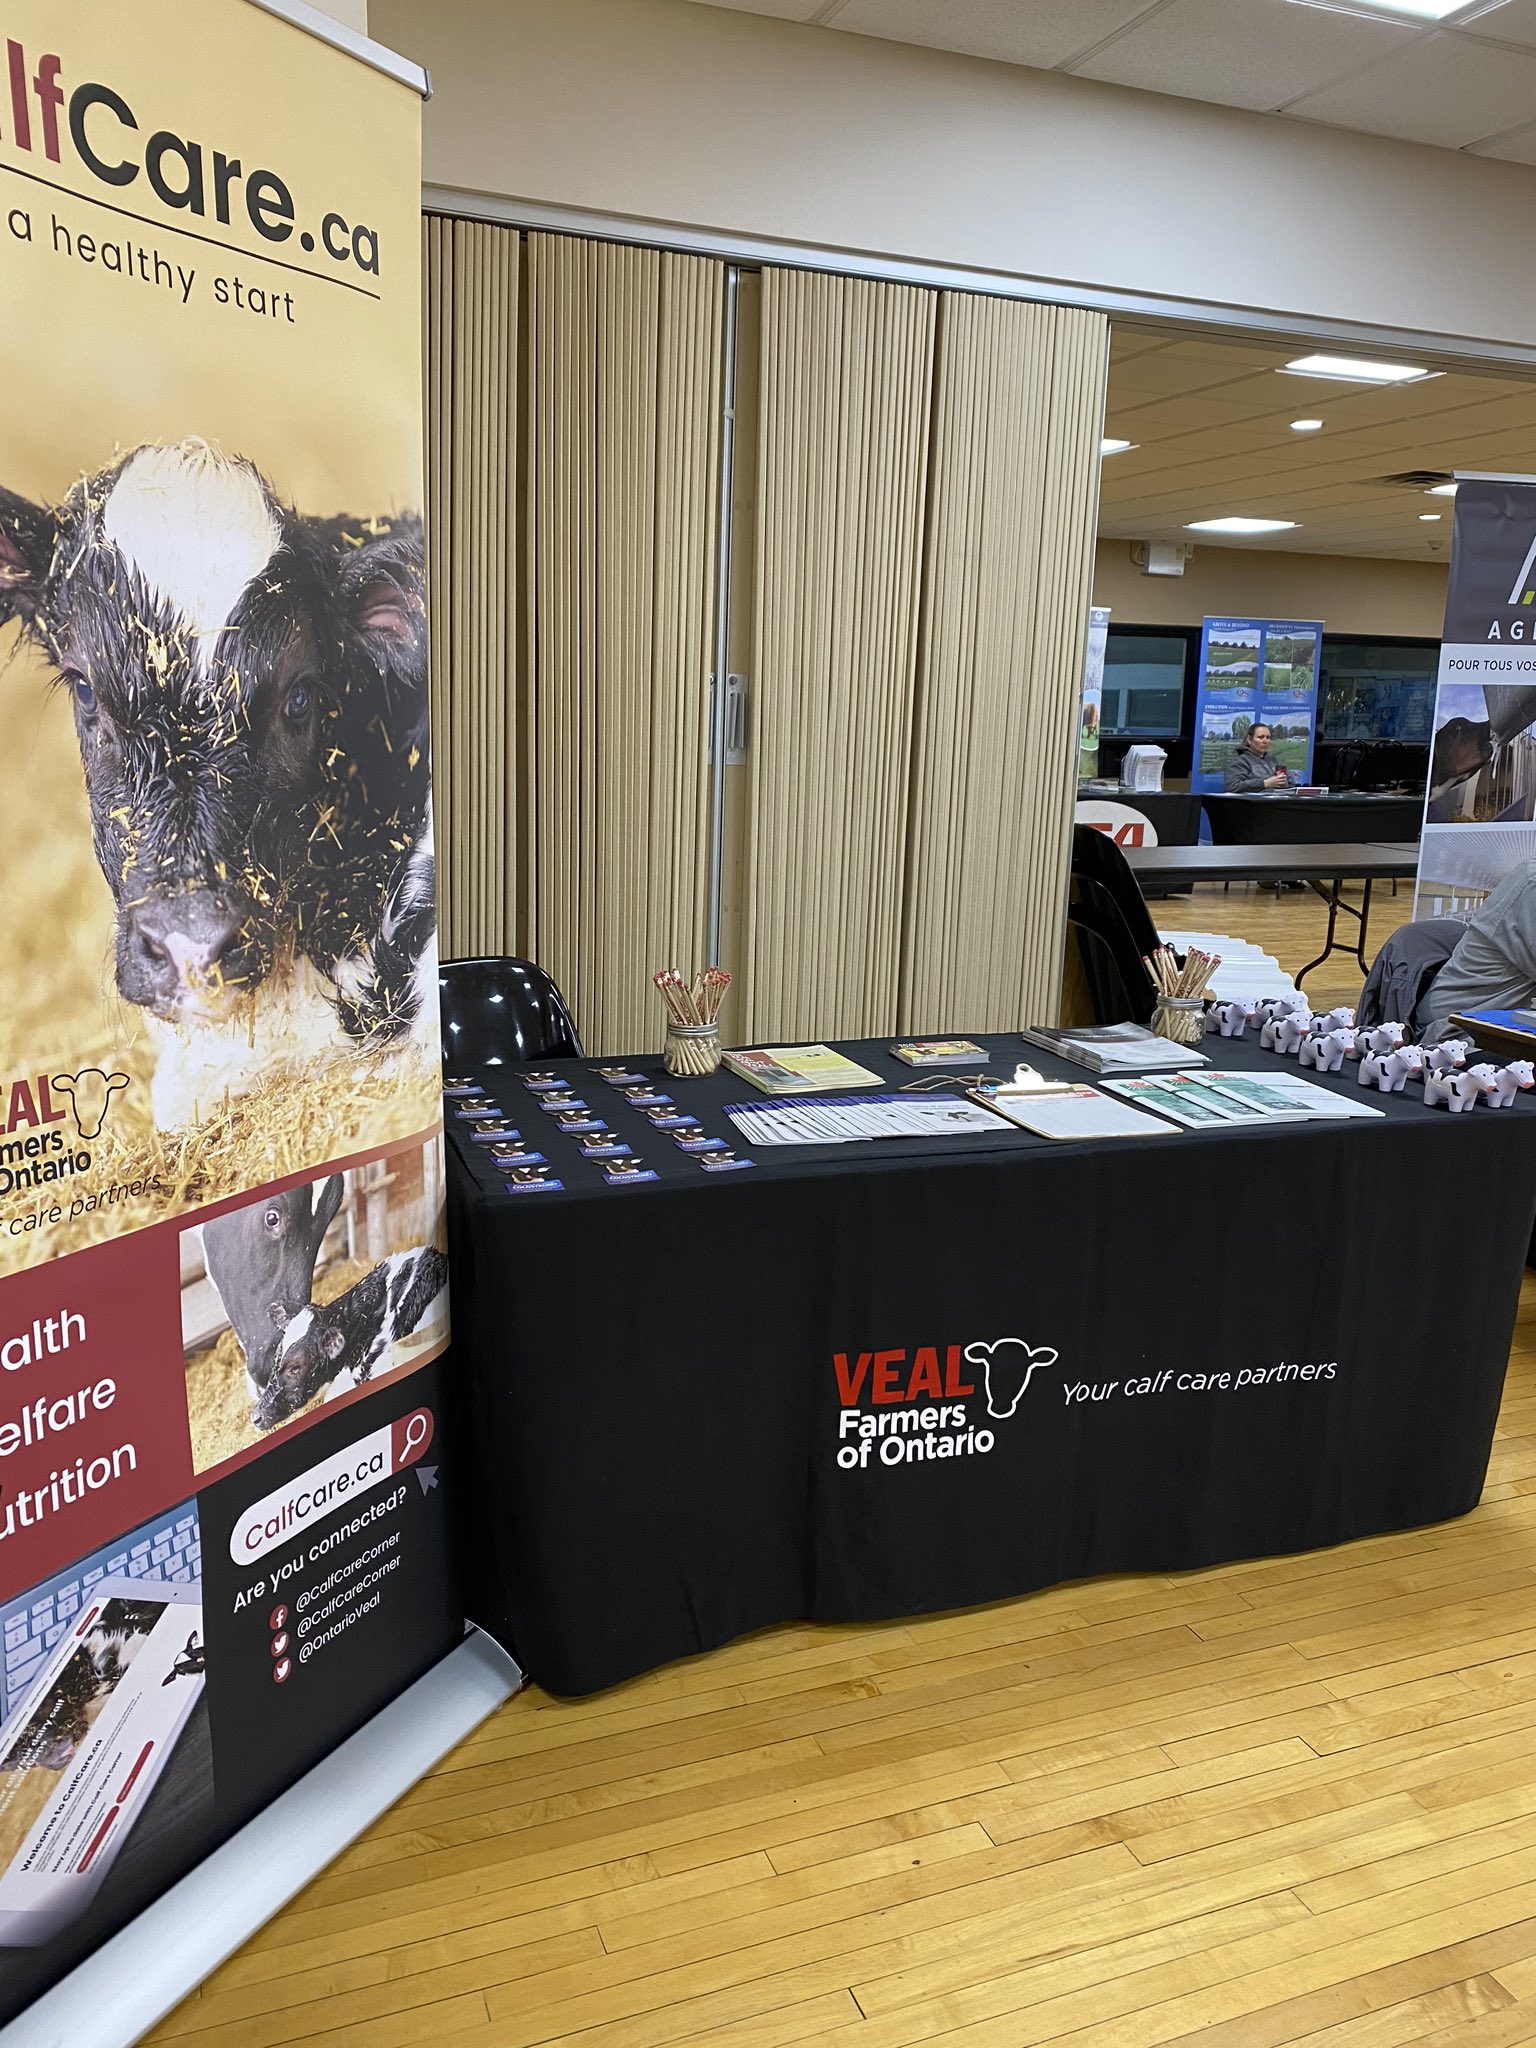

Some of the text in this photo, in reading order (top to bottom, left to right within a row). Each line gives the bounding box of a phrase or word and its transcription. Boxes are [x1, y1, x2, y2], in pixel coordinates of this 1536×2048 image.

[0, 38, 380, 276] lfCare.ca
[8, 209, 295, 323] a healthy start
[1487, 620, 1536, 640] AG
[1448, 660, 1479, 671] POUR
[1484, 660, 1512, 671] TOUS
[0, 1074, 66, 1134] AL
[10, 1174, 161, 1235] care partners
[0, 1309, 86, 1370] alth
[833, 1345, 974, 1406] VEAL
[1063, 1361, 1337, 1406] Your calf care partners
[837, 1425, 995, 1469] of Ontario
[839, 1404, 966, 1439] Farmers
[245, 1451, 383, 1550] CalfCare.ca
[234, 1486, 406, 1614] Are you connected?
[296, 1532, 400, 1613] @CalfCareCorner
[297, 1555, 401, 1638] @CalfCareCorner
[299, 1591, 380, 1663] @OntarioVeal
